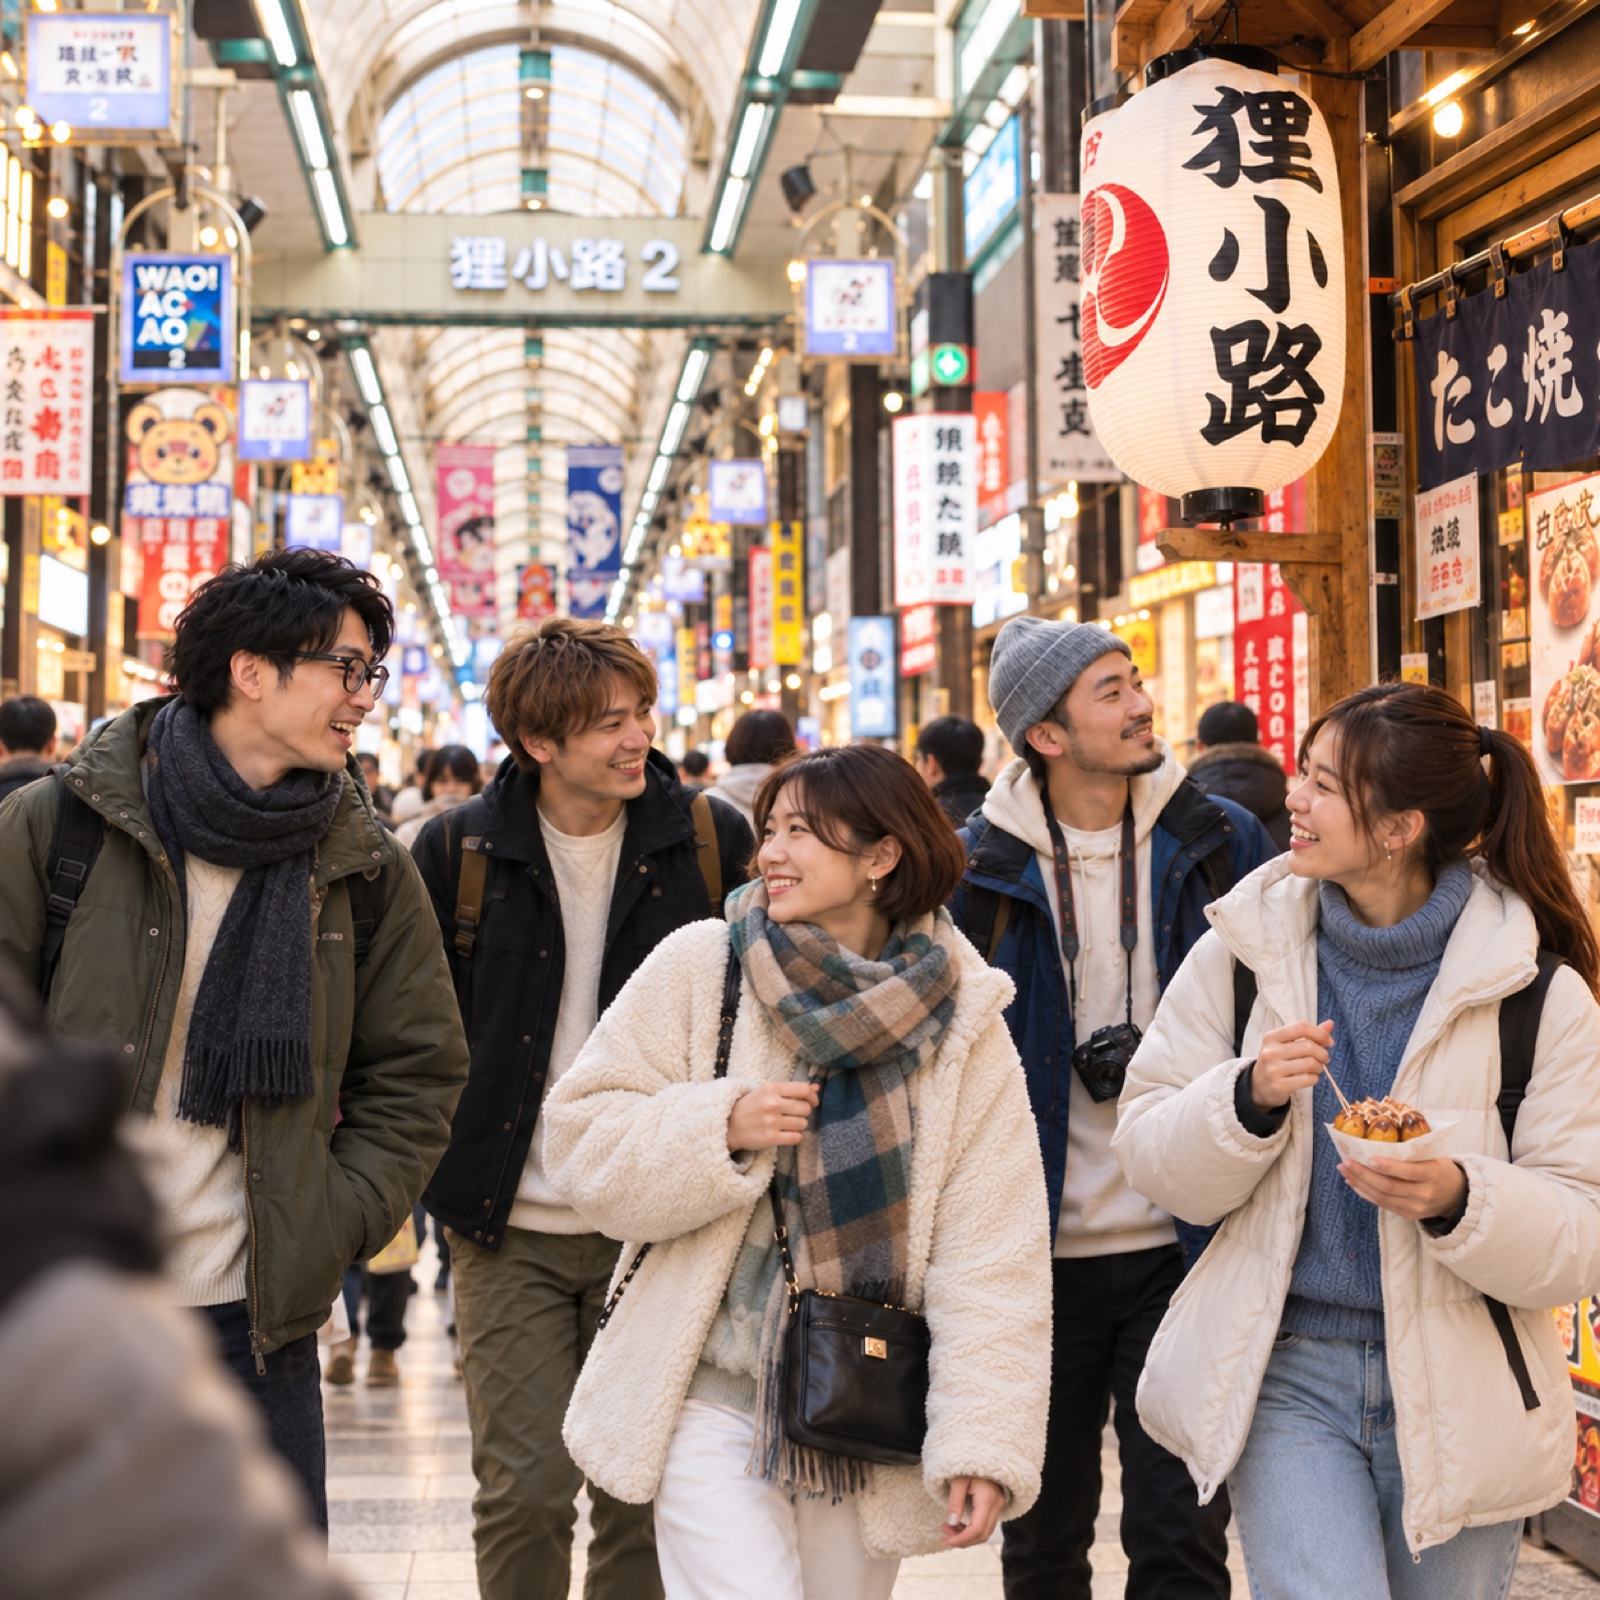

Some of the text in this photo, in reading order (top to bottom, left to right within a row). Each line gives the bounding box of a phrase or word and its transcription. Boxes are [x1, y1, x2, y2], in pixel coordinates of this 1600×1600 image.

[89, 96, 108, 120] 2
[135, 264, 218, 292] WAO!
[449, 236, 680, 291] 狸小路 2
[1181, 85, 1328, 448] 狸小路
[136, 317, 188, 346] AO
[1430, 308, 1600, 452] たこ焼
